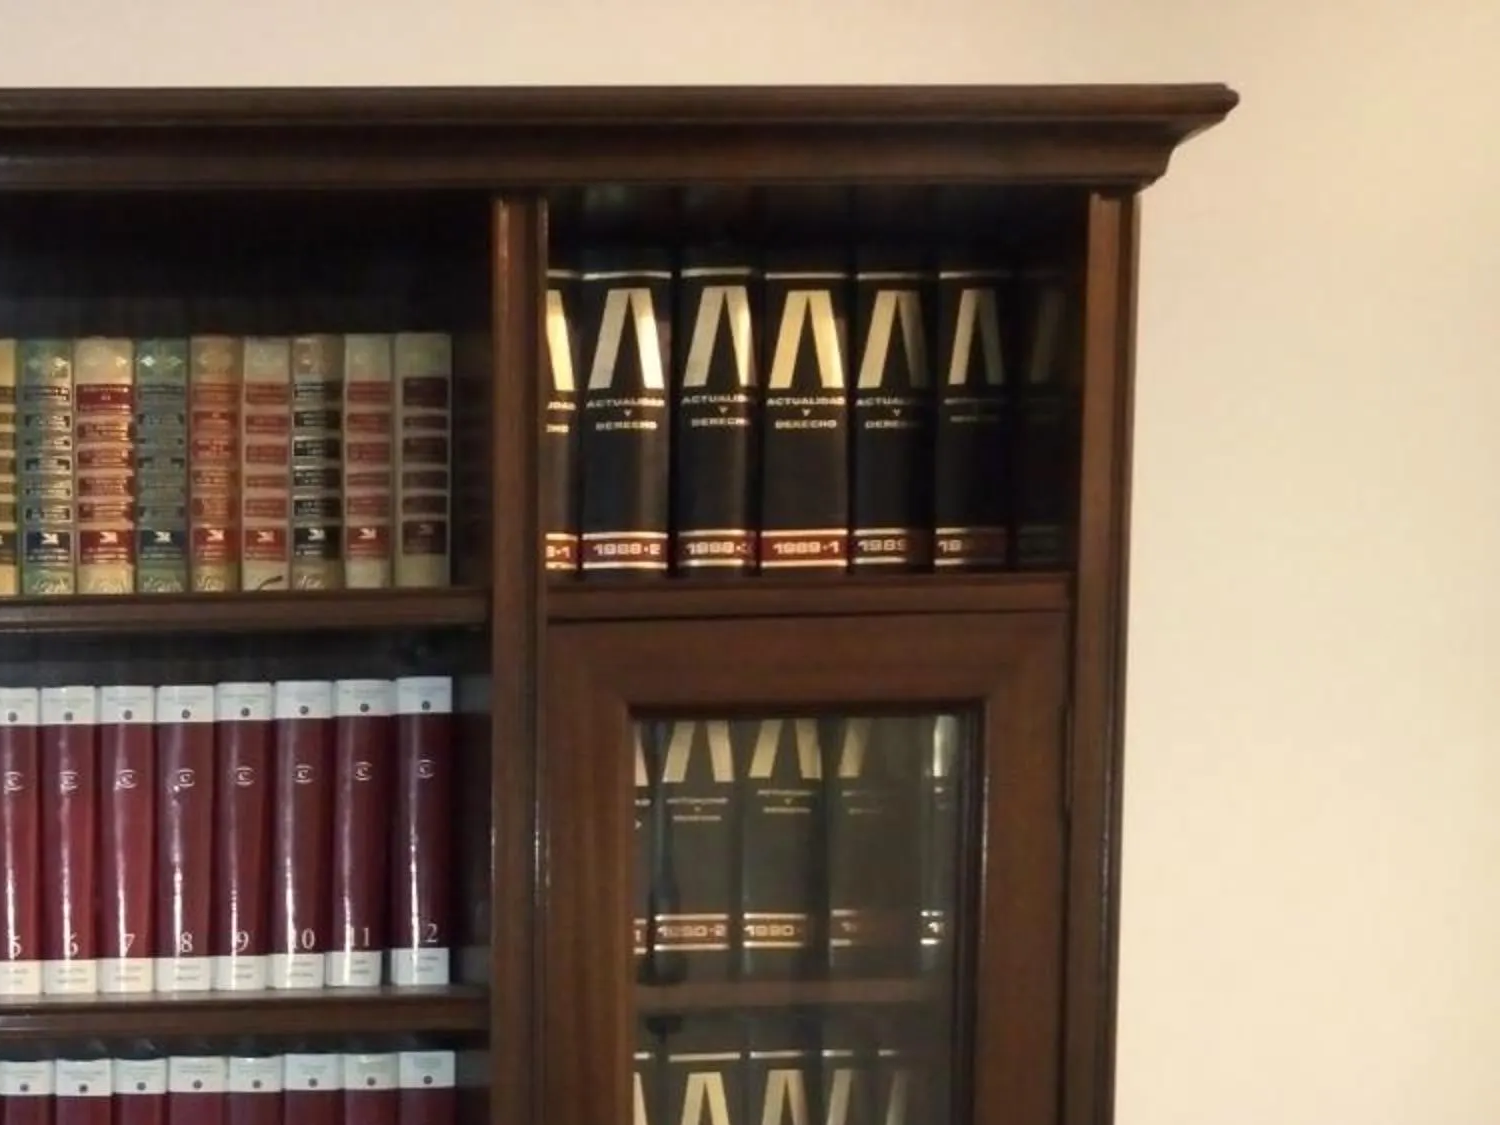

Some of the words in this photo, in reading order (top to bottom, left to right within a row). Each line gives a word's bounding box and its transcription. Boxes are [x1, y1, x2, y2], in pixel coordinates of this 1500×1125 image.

[766, 396, 846, 407] ACTUALIDAD
[773, 419, 838, 430] DERECHO
[178, 930, 193, 953] 8
[234, 930, 249, 951] 9
